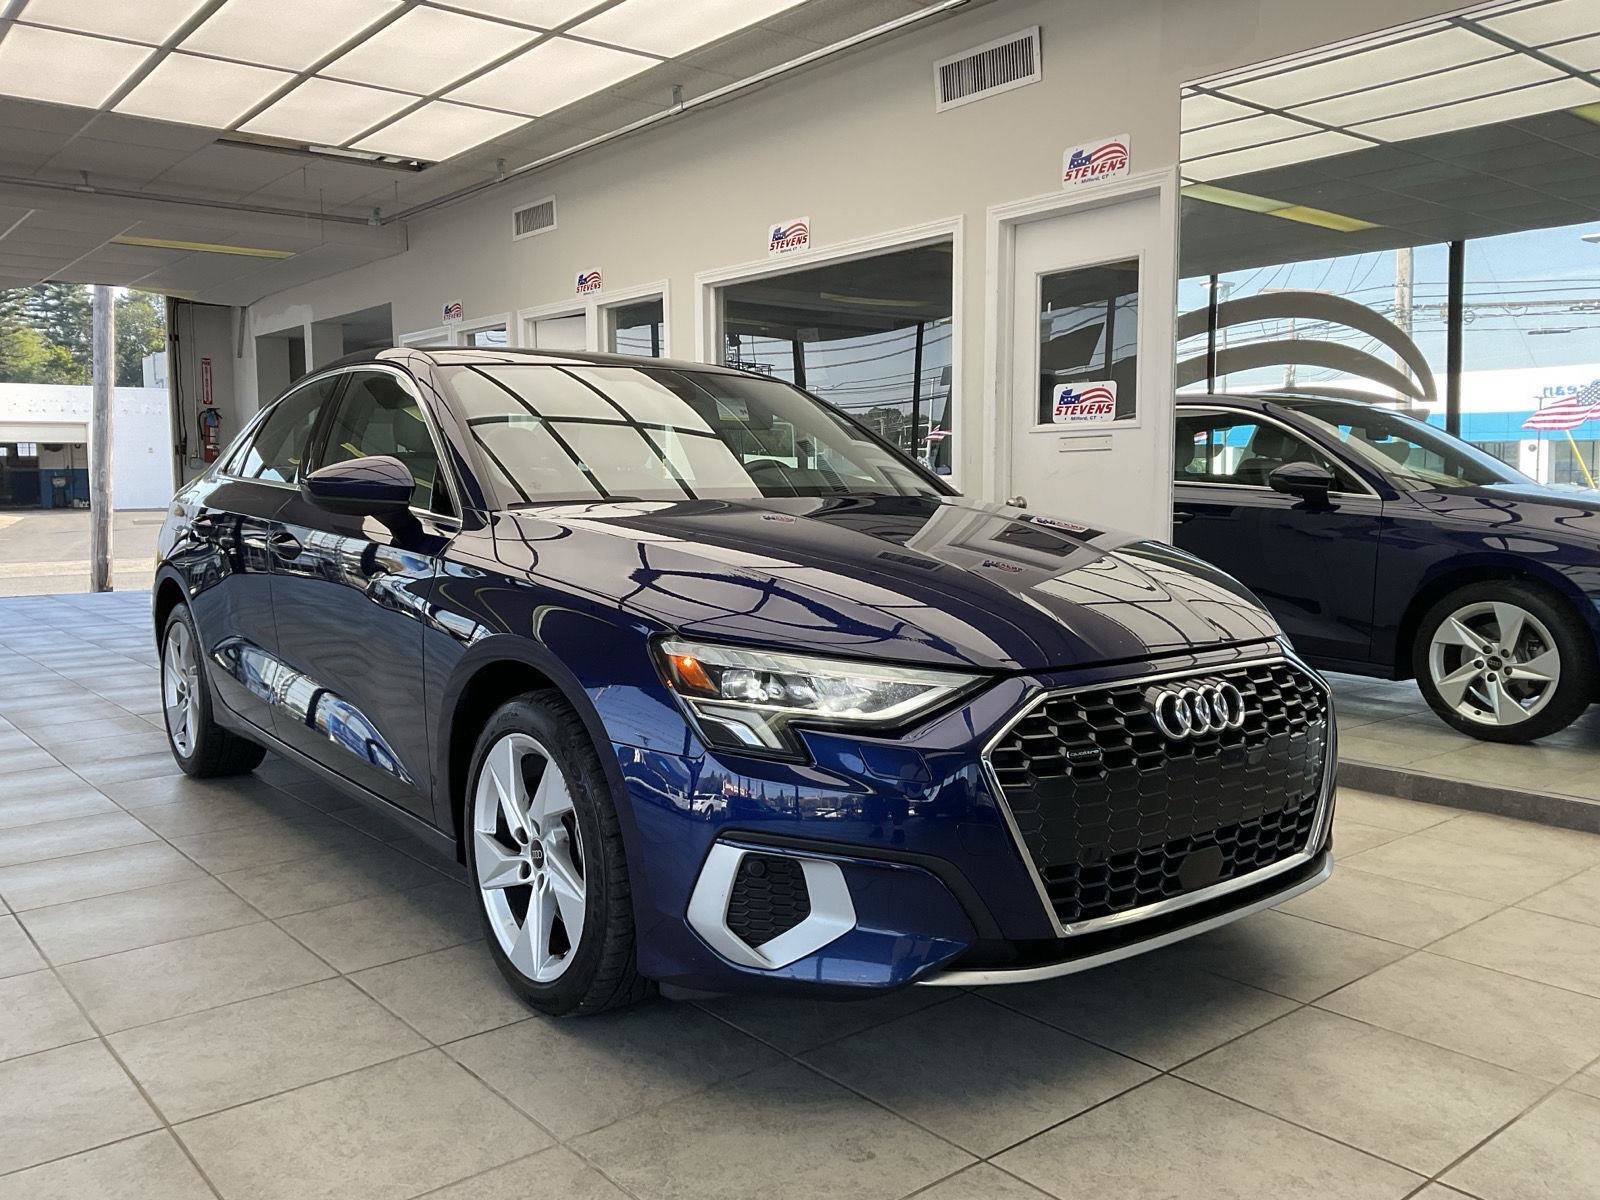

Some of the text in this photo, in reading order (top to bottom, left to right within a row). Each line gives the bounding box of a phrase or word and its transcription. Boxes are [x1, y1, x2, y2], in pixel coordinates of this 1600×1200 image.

[1064, 157, 1128, 182] STEVENS
[769, 234, 808, 251] STEVENS
[576, 281, 602, 293] STEVENS
[1054, 403, 1114, 416] STEVENS
